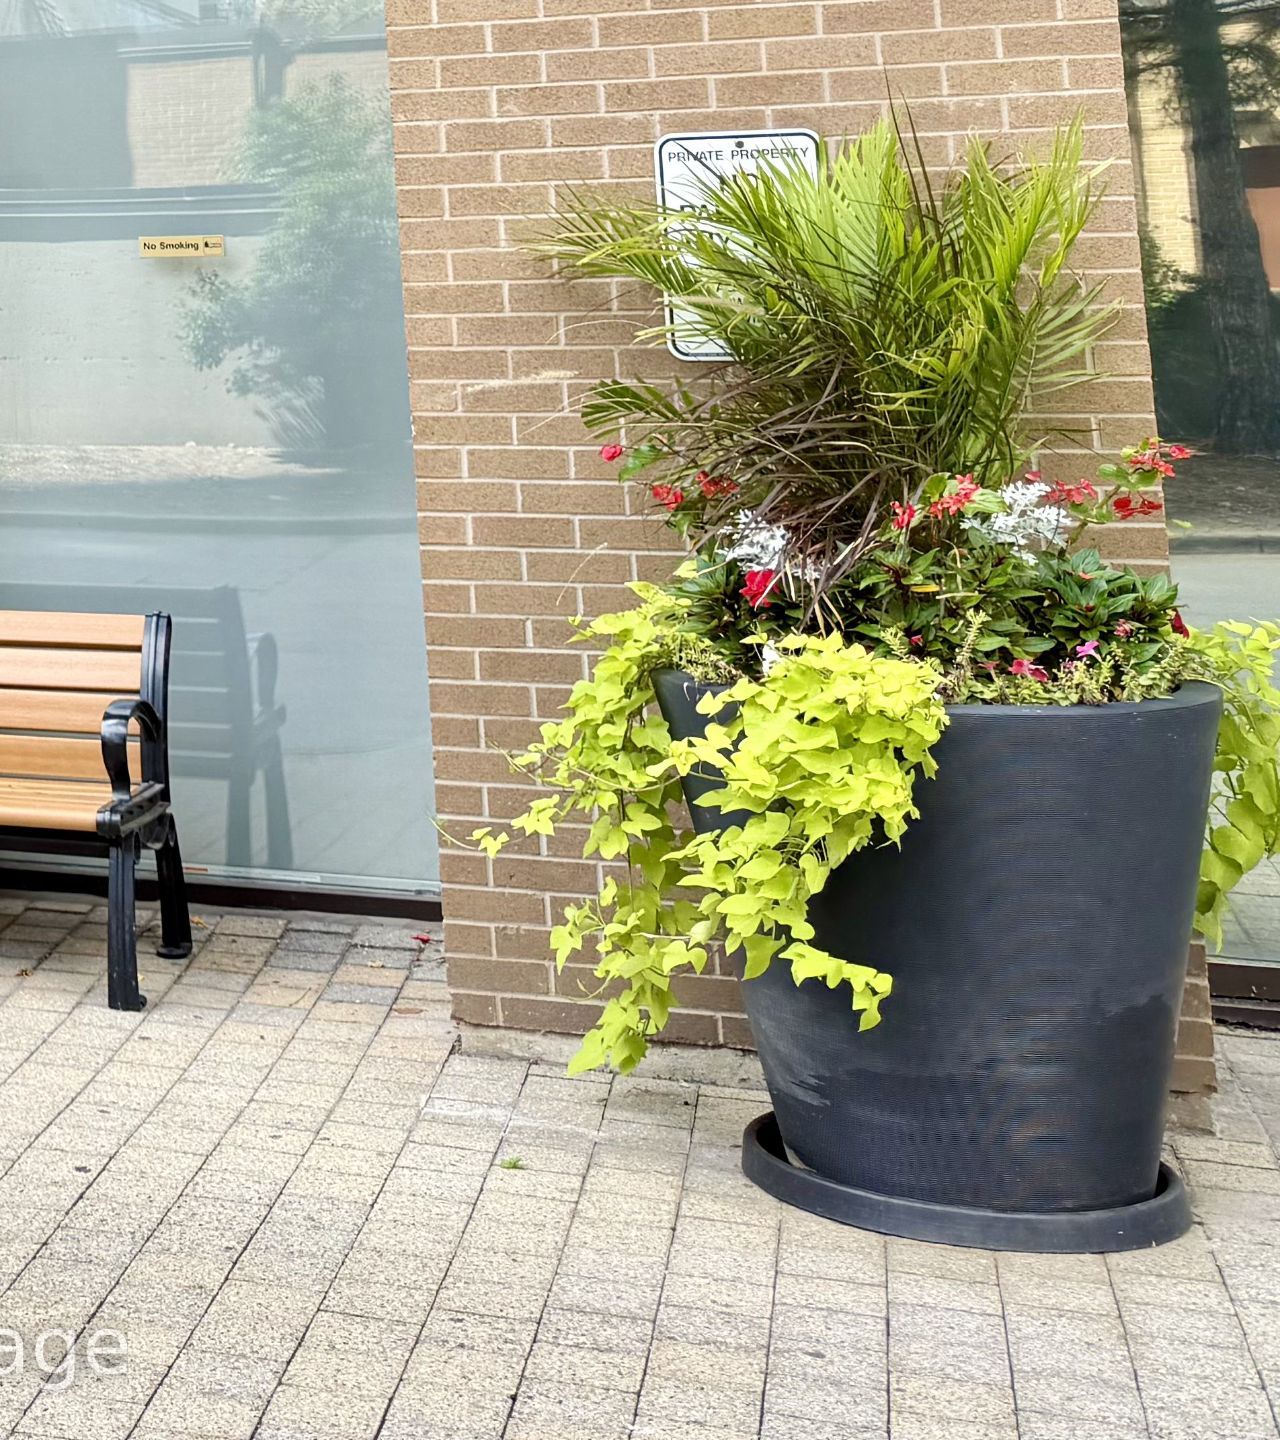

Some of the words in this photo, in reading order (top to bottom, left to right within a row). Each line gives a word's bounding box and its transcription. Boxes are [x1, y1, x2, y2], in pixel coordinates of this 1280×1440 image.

[668, 149, 724, 163] PRIVATE
[731, 146, 809, 160] PROPERTY
[143, 241, 157, 250] No
[160, 240, 200, 251] Smoking
